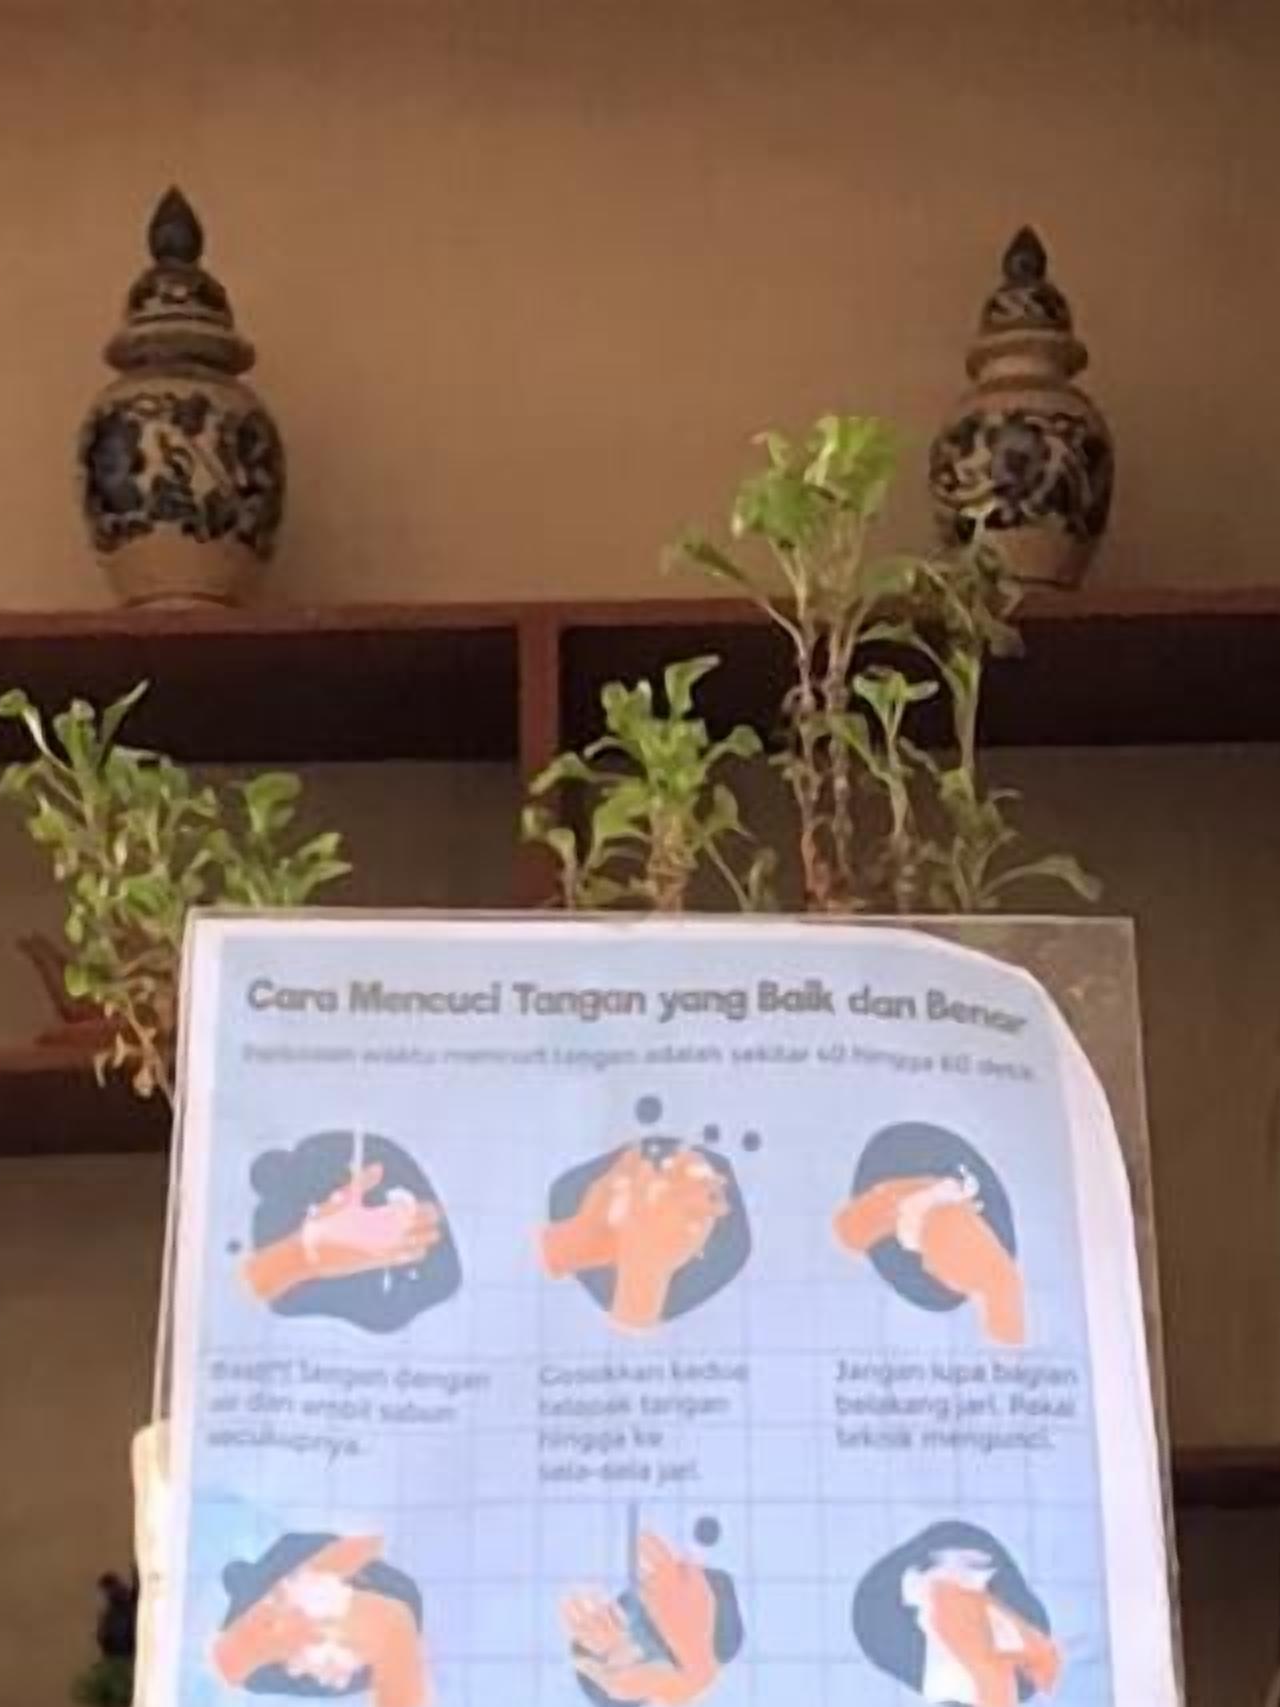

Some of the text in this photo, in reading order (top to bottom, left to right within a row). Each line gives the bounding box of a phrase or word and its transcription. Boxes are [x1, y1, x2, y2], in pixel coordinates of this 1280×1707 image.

[247, 978, 338, 1013] Cara
[348, 980, 502, 1013] Mencuci
[512, 982, 646, 1023] Tangan
[658, 988, 747, 1022] yang
[757, 979, 835, 1015] Baik
[848, 984, 916, 1019] dan
